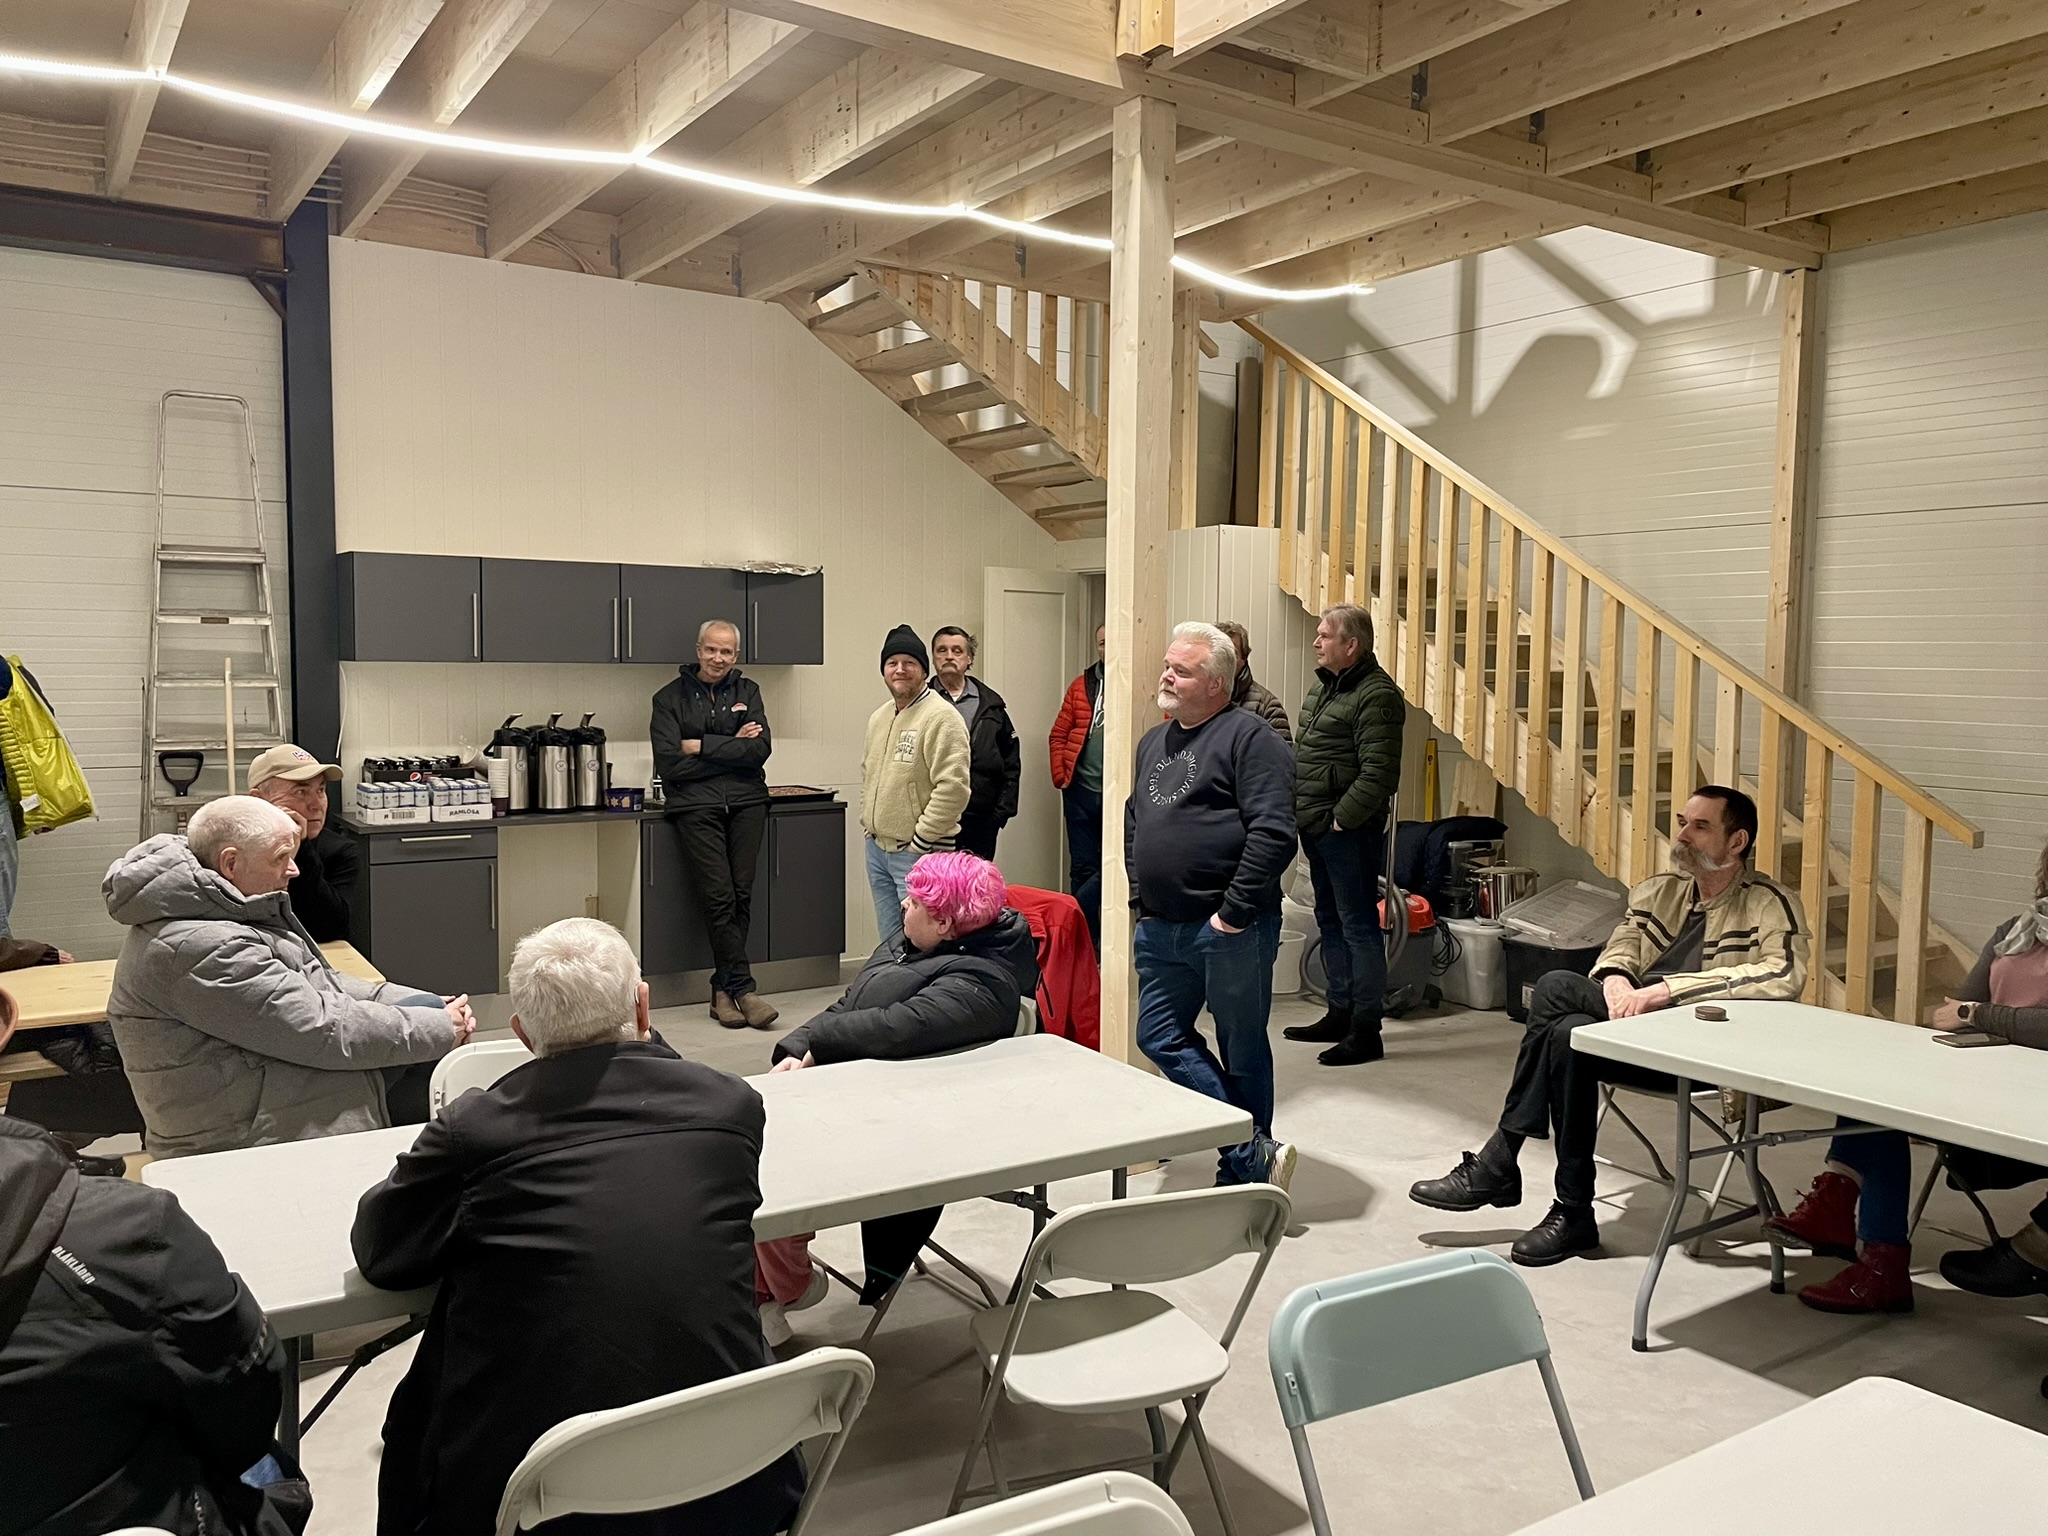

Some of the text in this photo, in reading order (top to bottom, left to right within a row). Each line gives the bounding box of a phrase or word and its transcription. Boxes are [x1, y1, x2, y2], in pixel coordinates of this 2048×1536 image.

[1149, 772, 1160, 796] 1993
[449, 808, 480, 816] RAMLÖSA
[51, 1245, 96, 1285] BLÅKLÄDER
